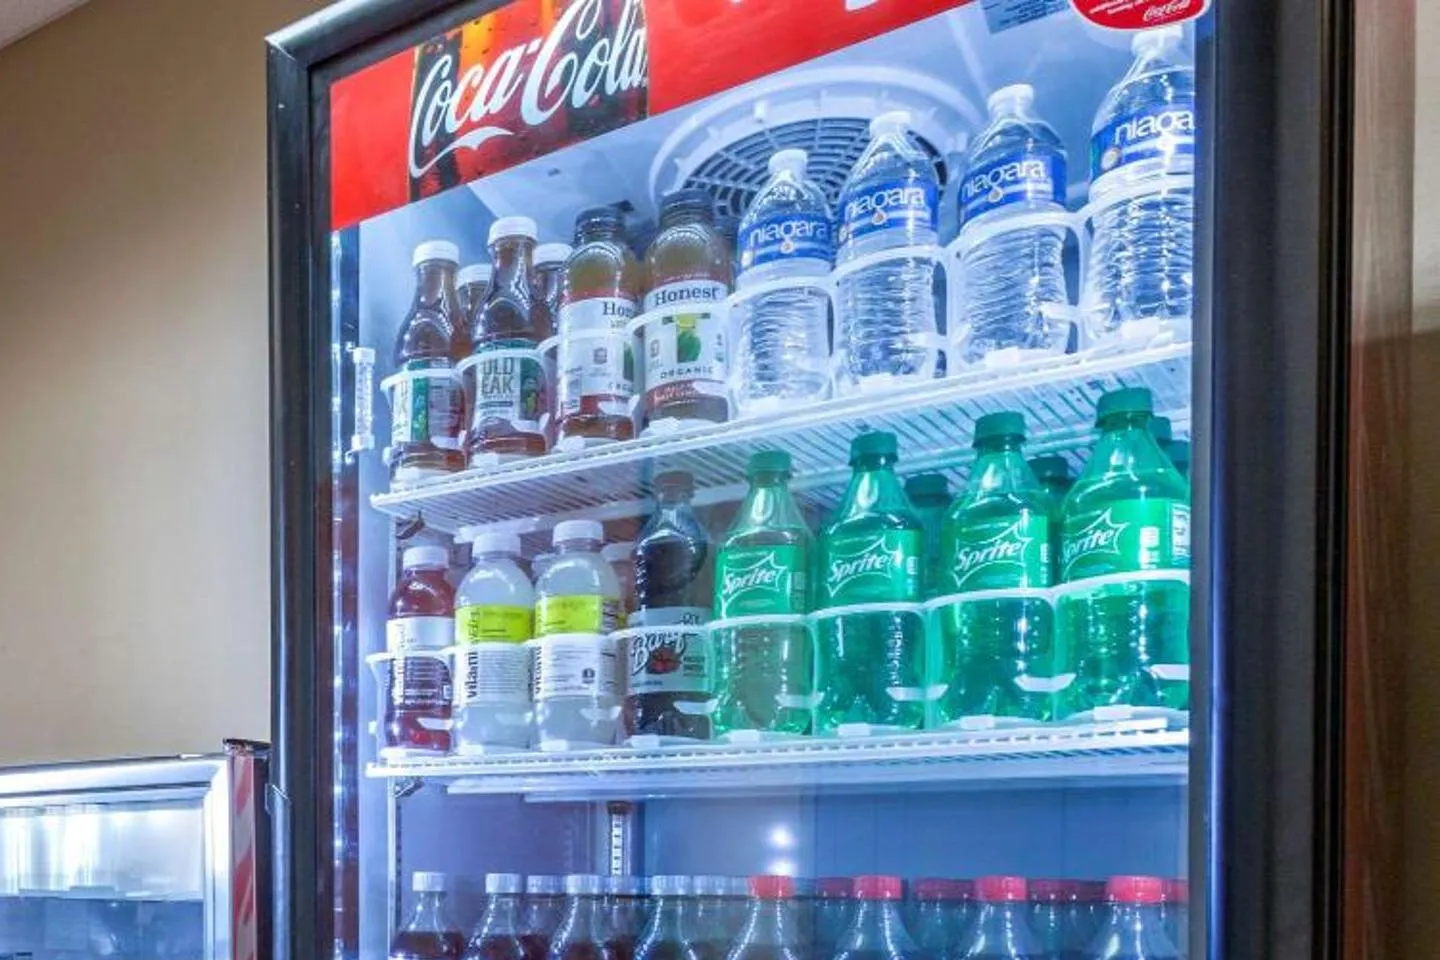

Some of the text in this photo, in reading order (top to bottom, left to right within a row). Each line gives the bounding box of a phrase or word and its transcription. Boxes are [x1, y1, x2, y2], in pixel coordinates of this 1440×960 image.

[409, 0, 648, 178] Coca-Cola
[1115, 110, 1194, 146] niaga
[961, 159, 1047, 200] niagara
[845, 187, 926, 221] niagara
[750, 219, 829, 247] niagara
[482, 375, 515, 395] EAK
[828, 552, 890, 583] Sprite
[955, 540, 1019, 571] Sprite
[722, 568, 777, 595] Sprite
